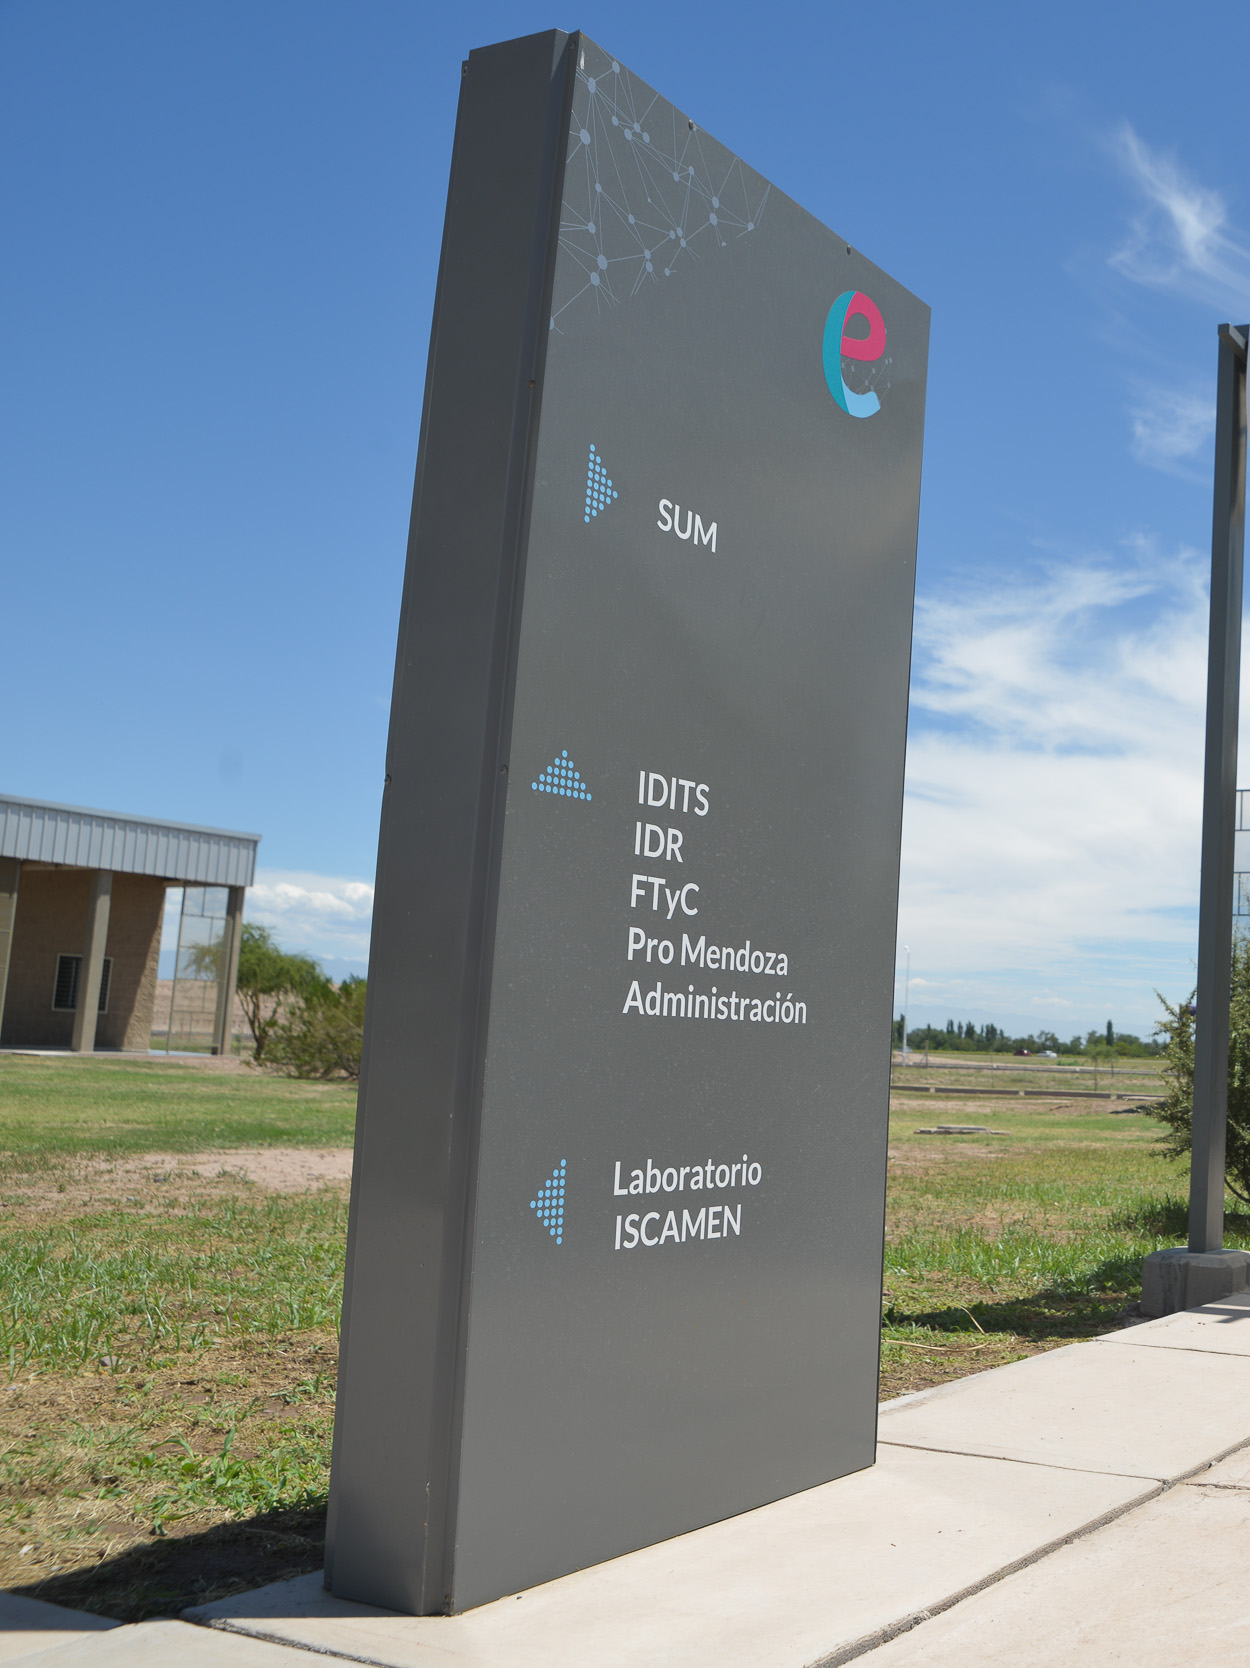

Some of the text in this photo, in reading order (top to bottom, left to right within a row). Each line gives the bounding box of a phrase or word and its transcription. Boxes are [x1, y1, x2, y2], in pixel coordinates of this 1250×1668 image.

[657, 498, 718, 553] SUM
[638, 770, 710, 816] IDITS
[634, 821, 683, 863] IDR
[630, 873, 700, 920] FTyC
[627, 926, 789, 976] Pro Mendoza
[622, 980, 807, 1024] Administración
[613, 1154, 762, 1196] Laboratorio
[614, 1204, 742, 1250] ISCAMEN
